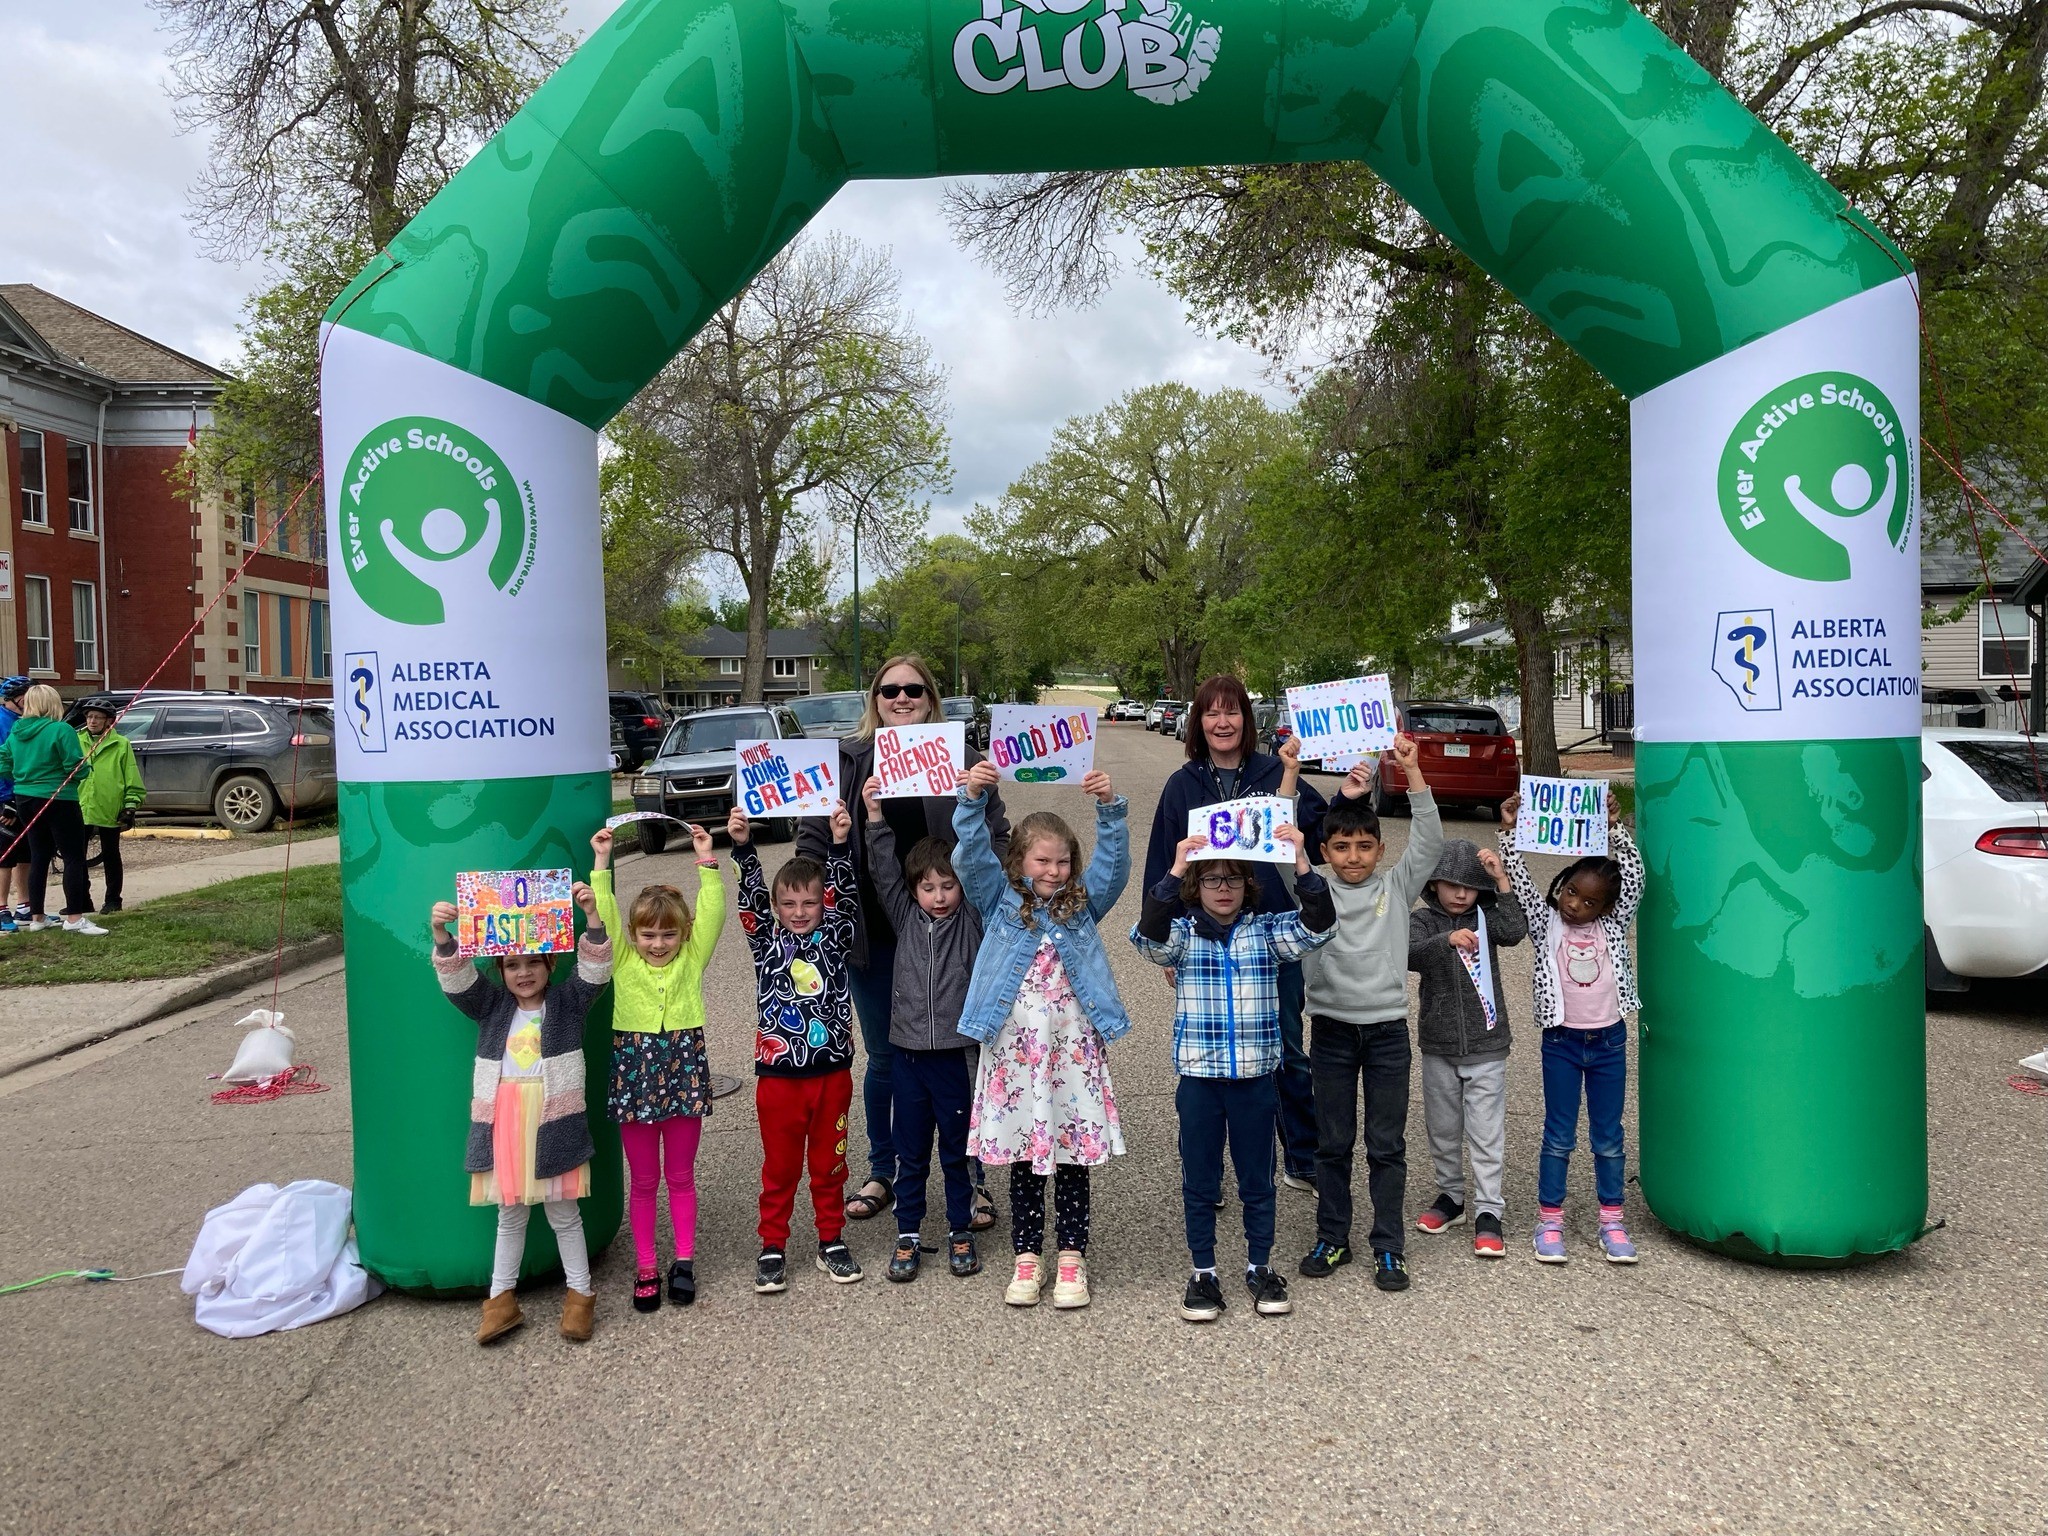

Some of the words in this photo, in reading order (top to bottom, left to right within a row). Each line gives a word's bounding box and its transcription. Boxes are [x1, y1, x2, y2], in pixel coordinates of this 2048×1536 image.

[952, 9, 1189, 95] CLUB
[1739, 393, 1815, 464] Active
[1820, 383, 1896, 448] Schools
[349, 437, 403, 506] Active
[406, 428, 498, 491] Schools
[1736, 469, 1766, 531] Ever
[348, 511, 369, 573] Ever
[508, 479, 539, 598] www.everactive.org
[1791, 618, 1888, 640] ALBERTA
[391, 660, 492, 683] ALBERTA
[1792, 648, 1893, 669] MEDICAL
[393, 689, 501, 712] MEDICAL
[1791, 676, 1920, 699] ASSOCIATION
[394, 716, 556, 742] ASSOCIATION
[992, 725, 1048, 769] GOOD
[1050, 712, 1093, 754] JOB!
[1295, 706, 1333, 739] WAY
[1334, 703, 1359, 733] TO
[1361, 698, 1391, 730] GO!
[877, 728, 902, 760] GO
[878, 736, 951, 788] FRIENDS
[741, 755, 790, 790] DOING
[744, 762, 835, 816] GREAT!
[1530, 781, 1565, 815] YOU
[1569, 784, 1602, 816] CAN
[1209, 805, 1275, 854] GO!
[1537, 817, 1564, 846] DO
[1566, 818, 1591, 848] IT!
[500, 877, 528, 909] GO
